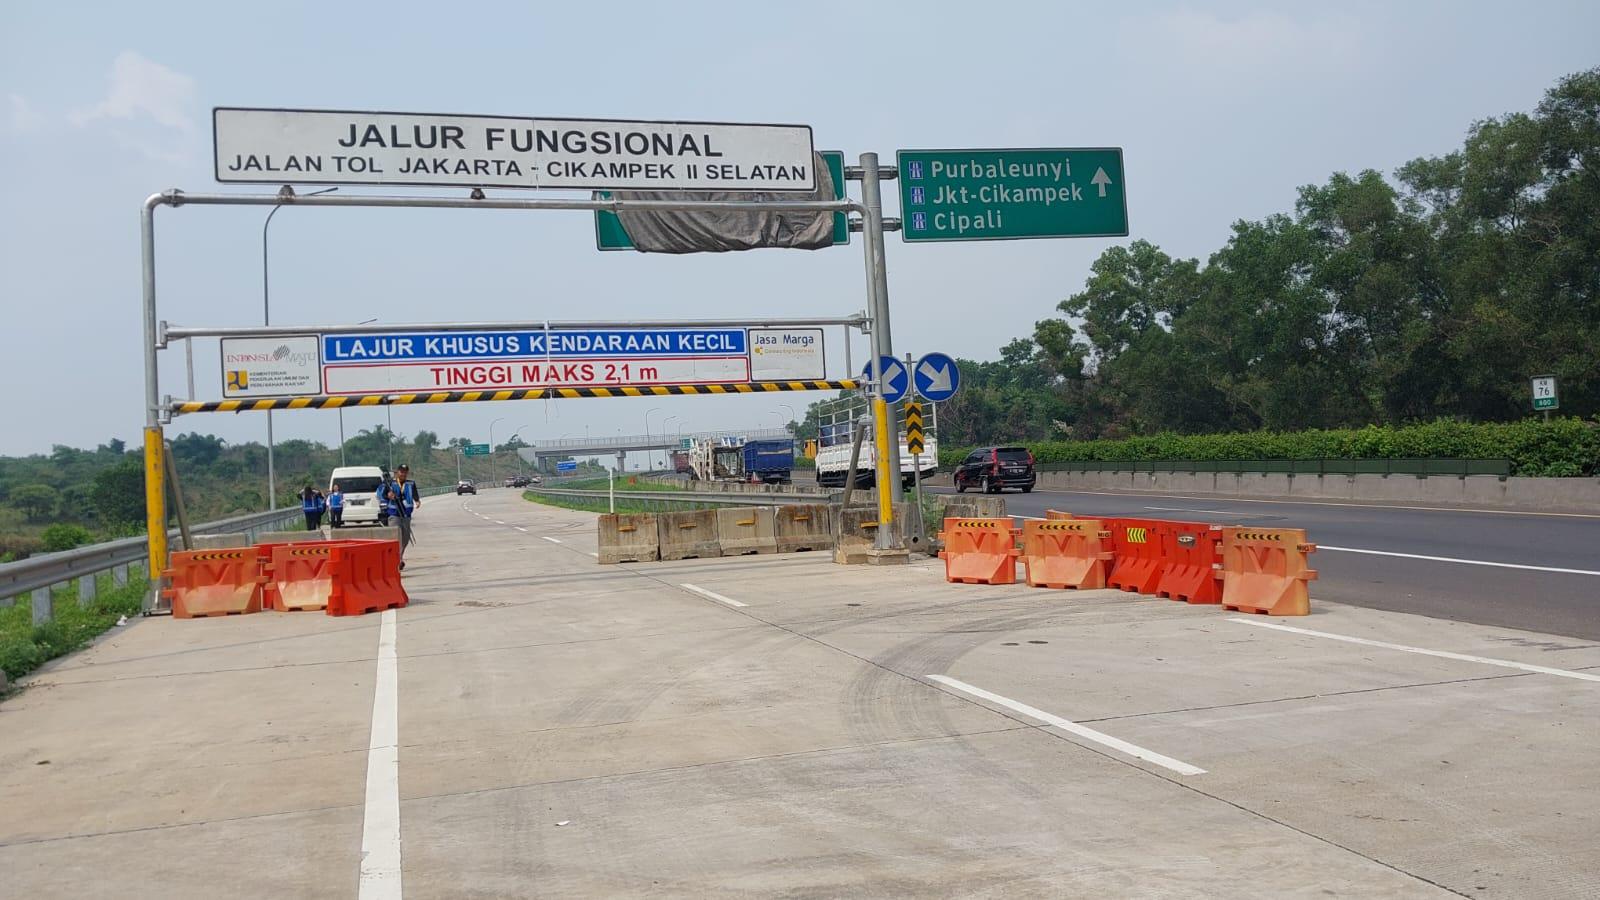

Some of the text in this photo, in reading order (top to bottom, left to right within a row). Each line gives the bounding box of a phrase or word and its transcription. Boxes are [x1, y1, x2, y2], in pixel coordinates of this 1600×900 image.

[338, 124, 723, 157] JALUR FUNGSIONAL
[228, 155, 322, 174] JALAN
[331, 156, 383, 174] TOL
[399, 157, 521, 177] JAKARTA
[546, 160, 675, 180] CIKAMPEK
[687, 164, 698, 180] II
[706, 163, 806, 182] SELATAN
[931, 159, 1071, 181] Purbaleunyi
[933, 183, 1083, 206] Jkt-Cikampek
[934, 210, 1002, 234] Cipali
[335, 333, 737, 358] LAJUR KHUSUS KENDARAAN KECIL
[755, 334, 814, 347] Jasa Marga
[430, 363, 657, 386] TINGGI MAKS 2,1 m
[1538, 387, 1550, 396] 76
